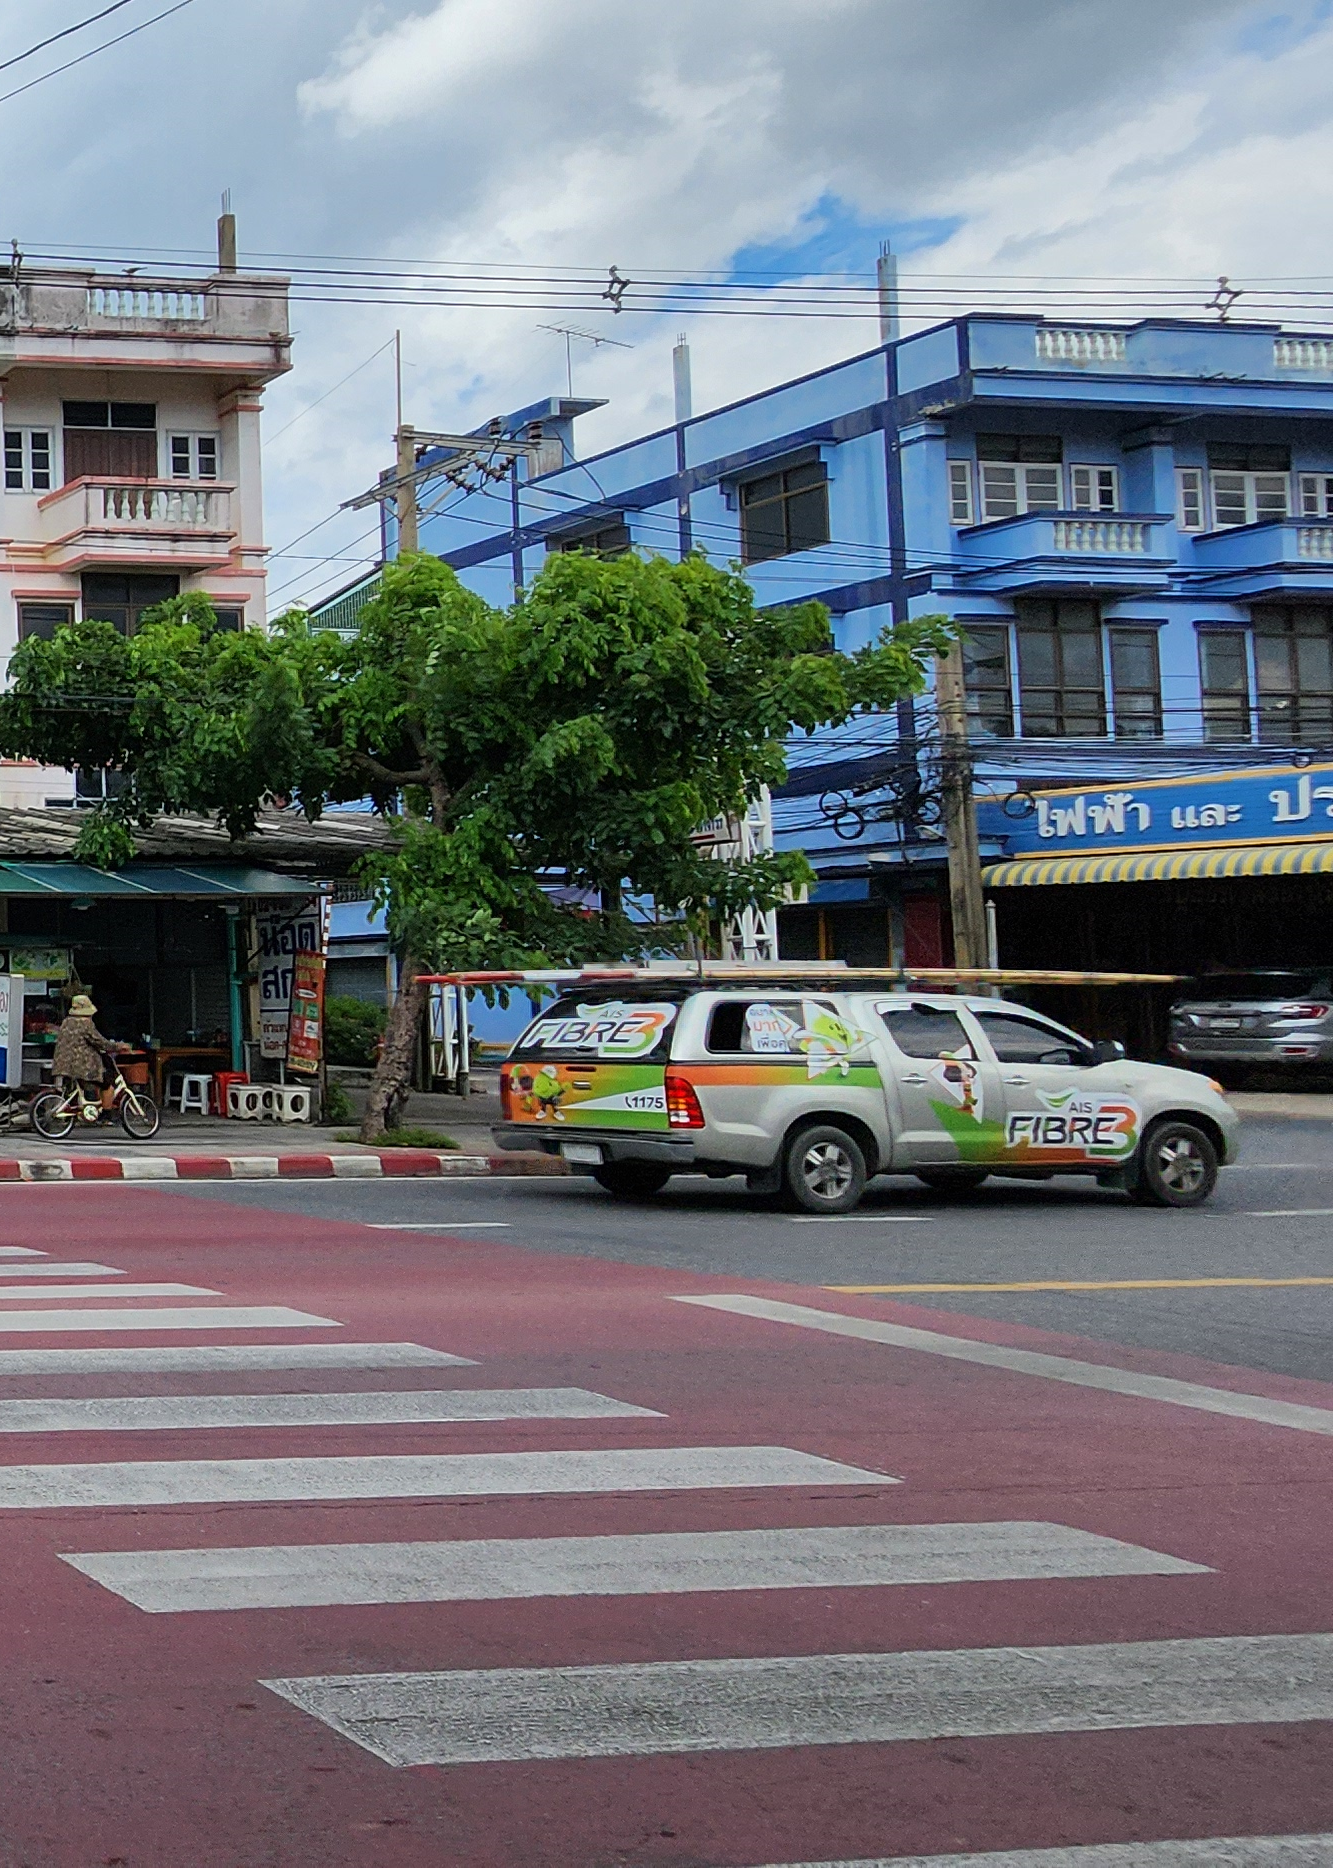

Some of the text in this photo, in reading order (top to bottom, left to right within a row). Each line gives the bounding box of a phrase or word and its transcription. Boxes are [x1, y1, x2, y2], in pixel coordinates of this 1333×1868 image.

[1035, 792, 1151, 839] ไฟฟ้า
[1171, 803, 1242, 829] และ
[599, 1008, 625, 1018] AIS
[631, 1096, 664, 1109] 1175
[1068, 1101, 1093, 1113] AIS
